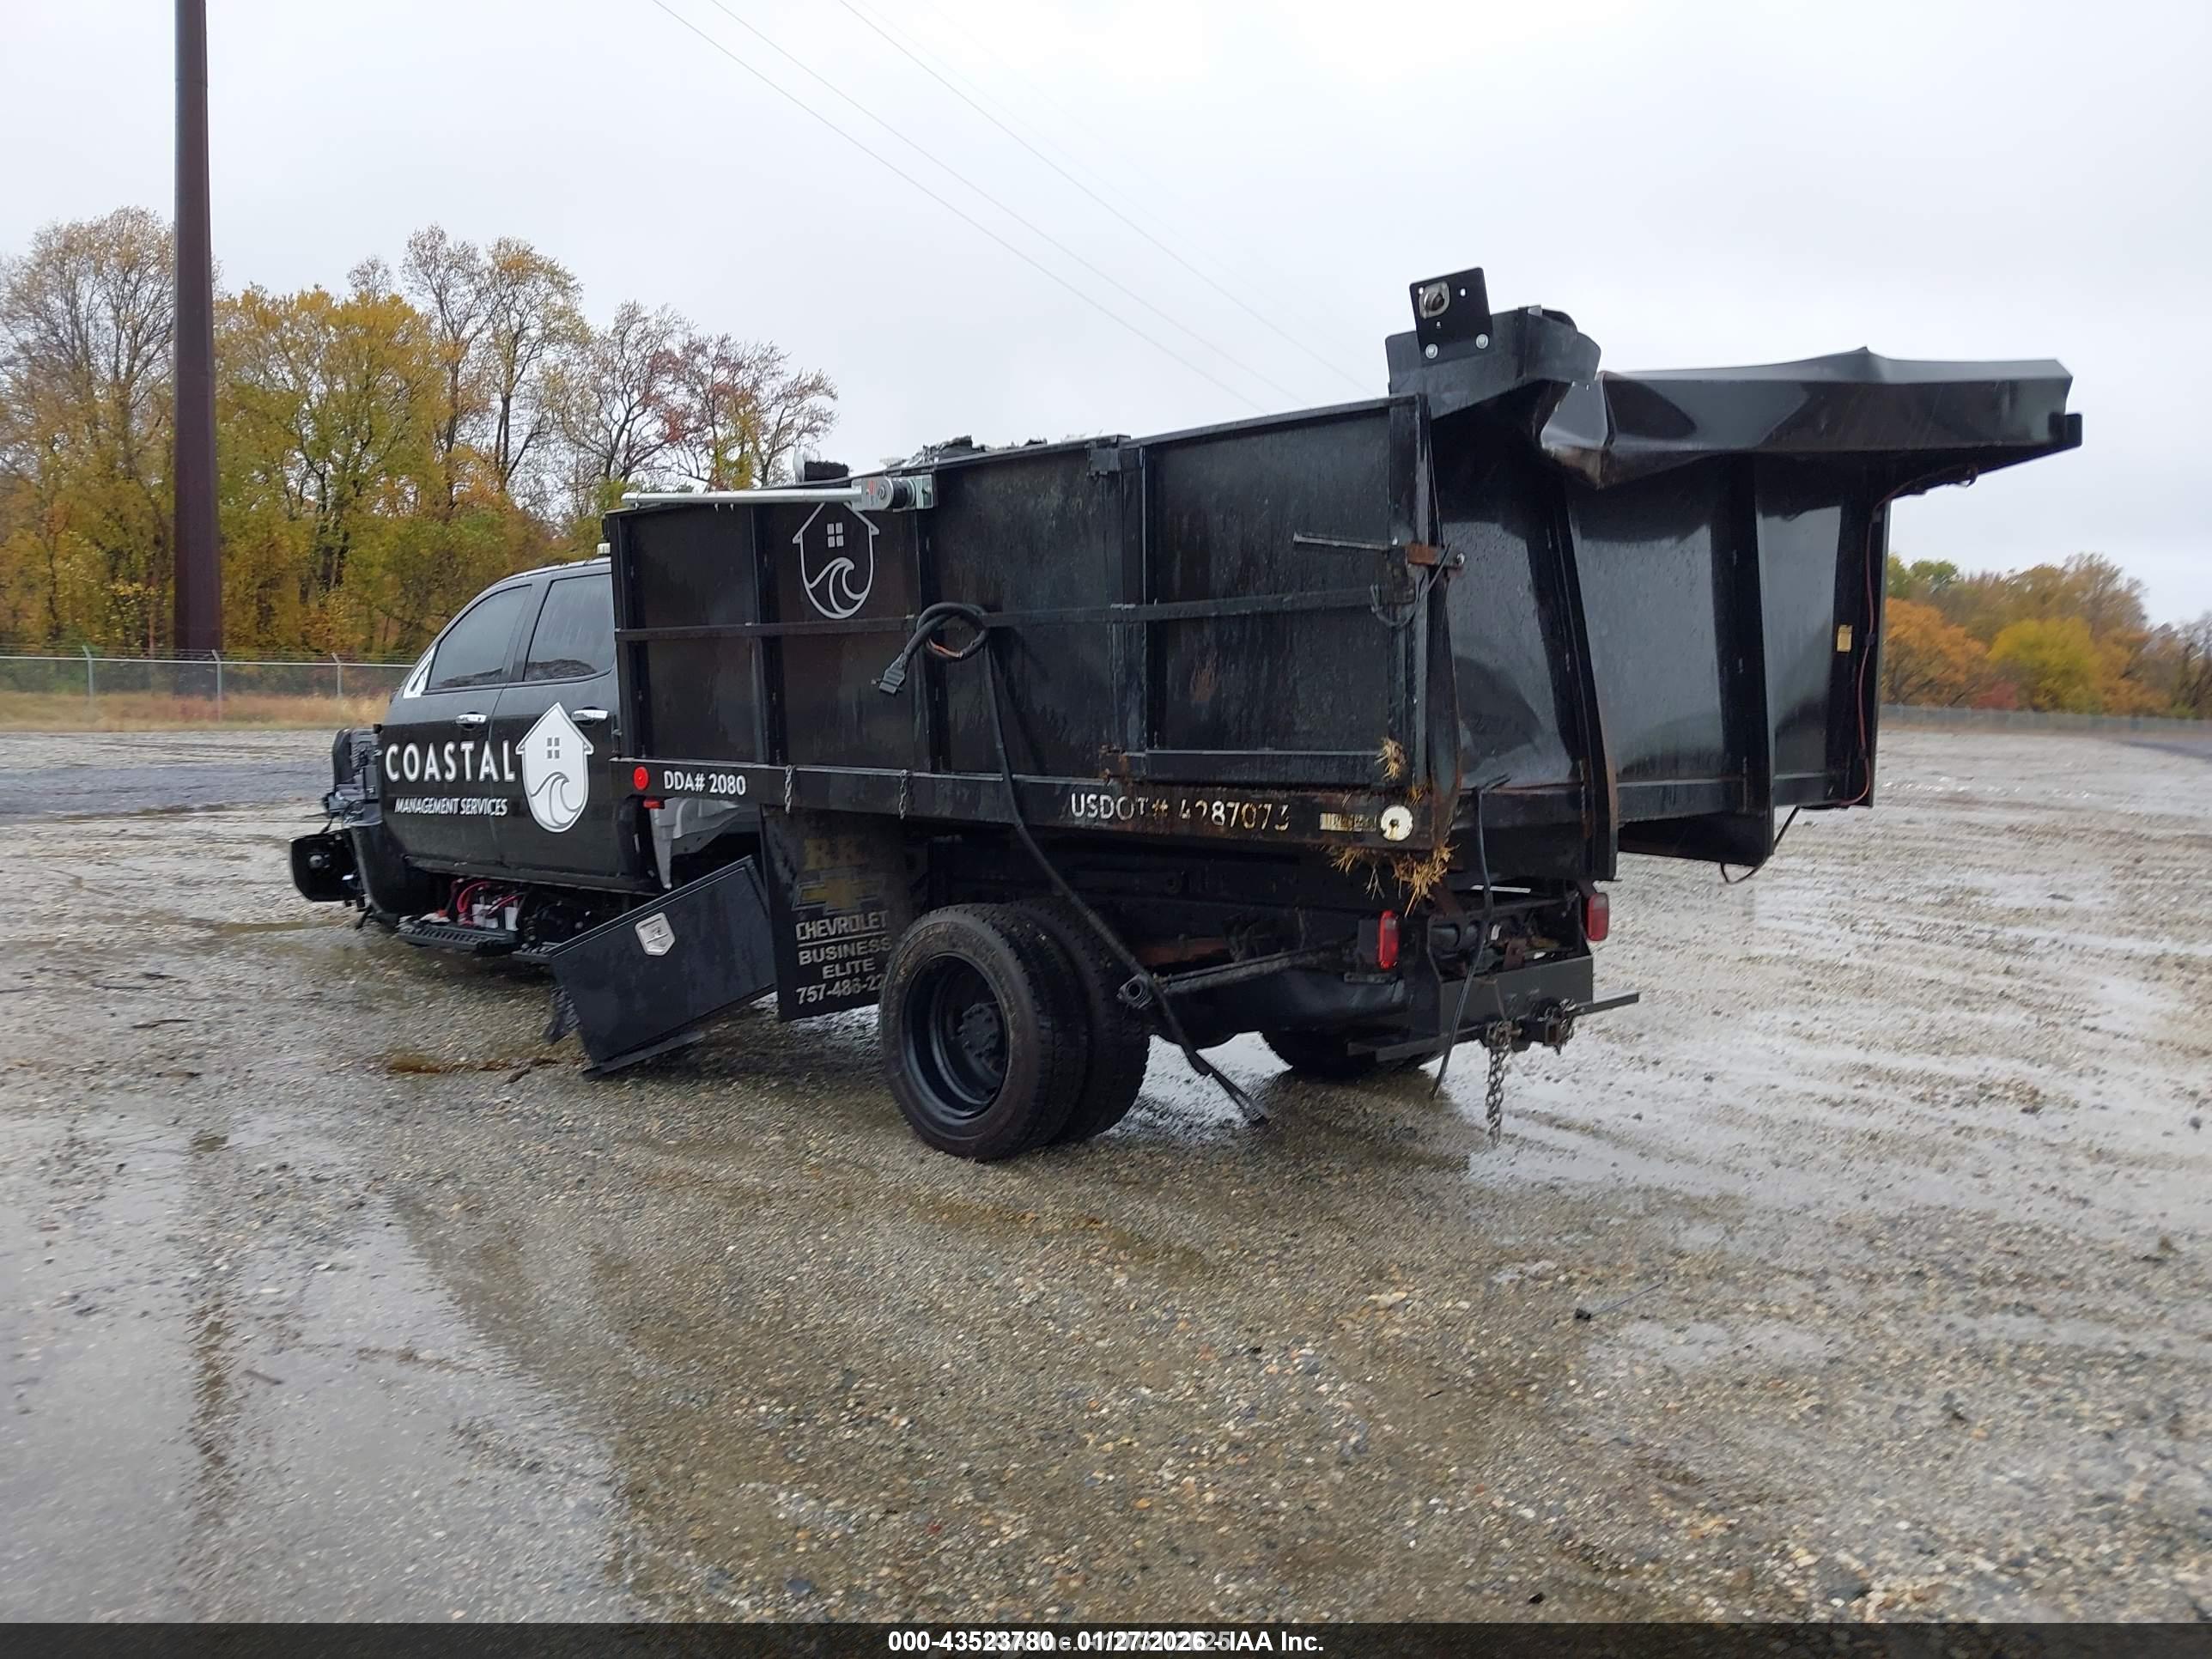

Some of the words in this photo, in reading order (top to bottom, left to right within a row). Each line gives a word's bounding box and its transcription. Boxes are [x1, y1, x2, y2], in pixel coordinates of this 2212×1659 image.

[386, 739, 516, 782] COASTAL
[664, 770, 705, 792] DDA#
[708, 773, 746, 795] 2080
[394, 797, 459, 815] MANAGEMENT
[460, 798, 508, 816] SERVICES
[1071, 793, 1169, 821] USDOT#
[796, 910, 889, 940] CHEVROLET
[799, 937, 892, 965] BUSINESS
[823, 957, 876, 979] ELITE
